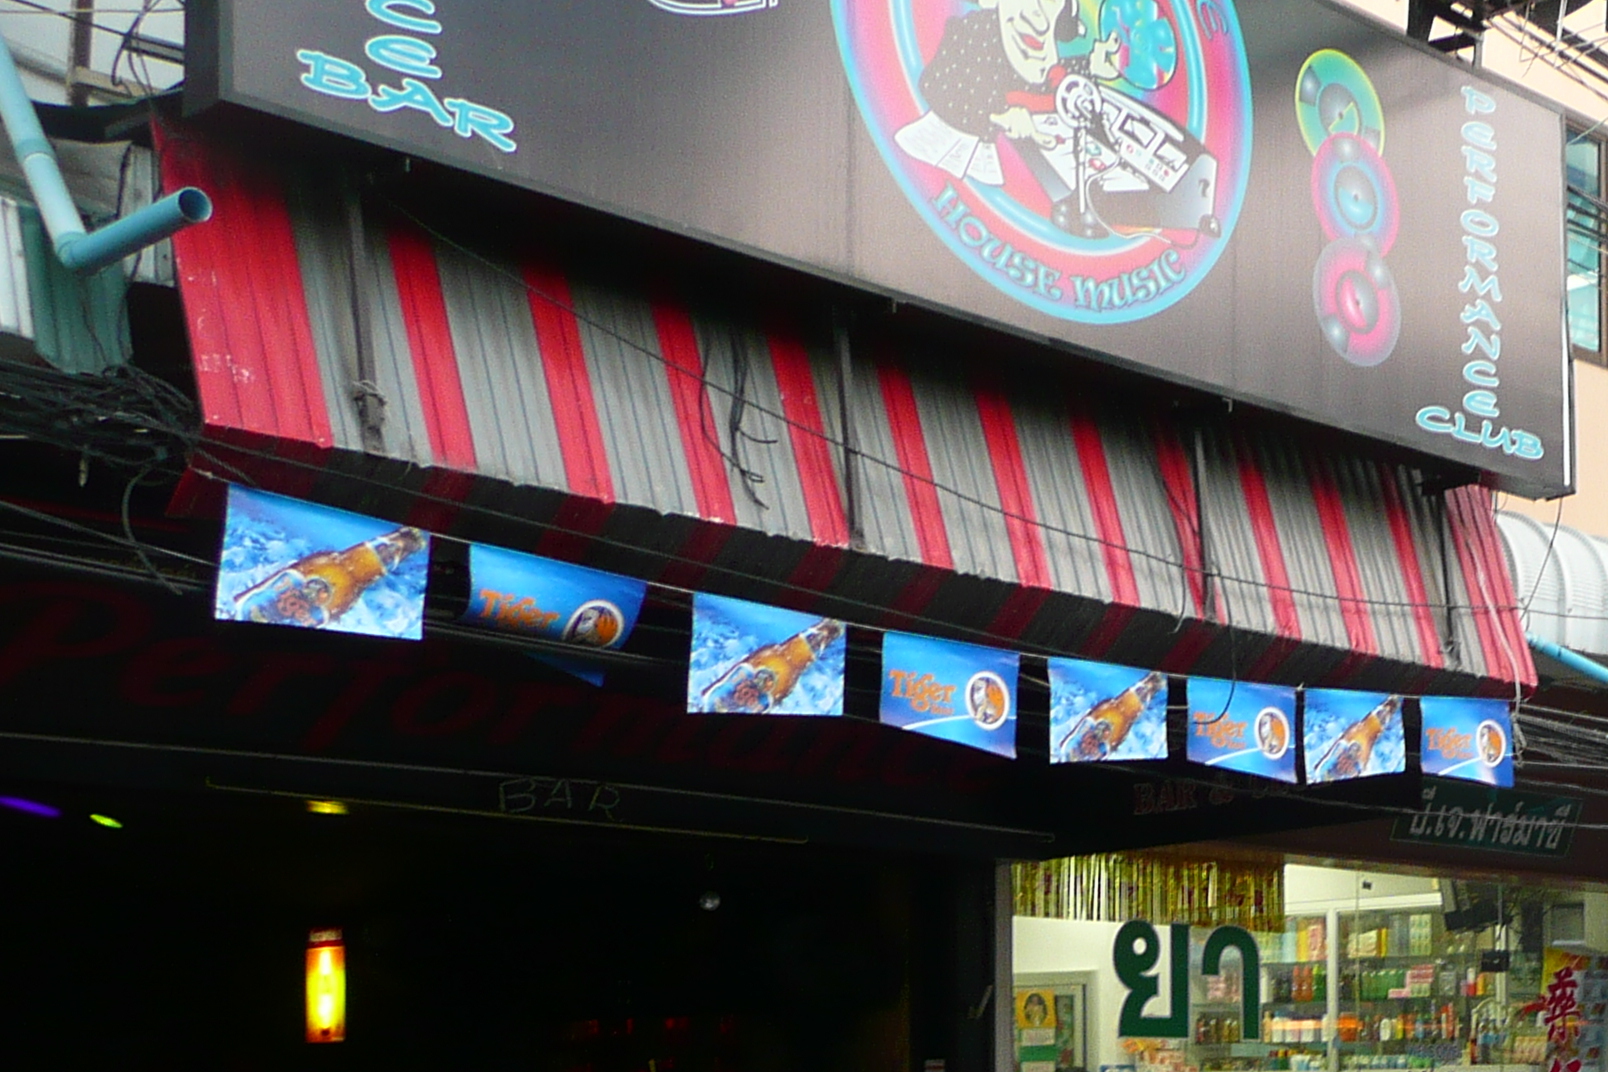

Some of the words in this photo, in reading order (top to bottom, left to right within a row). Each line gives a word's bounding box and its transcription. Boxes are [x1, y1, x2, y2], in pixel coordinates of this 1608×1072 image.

[297, 48, 517, 152] BAR
[932, 178, 1066, 301] HOUSE
[1068, 247, 1188, 313] MUSIC
[1458, 84, 1502, 418] PERFORMANCE
[1415, 405, 1544, 460] CLUB
[888, 668, 958, 712] Tiger
[1192, 711, 1248, 749] Tiger
[1425, 727, 1474, 759] Tiger
[1112, 918, 1262, 1041] ยา
